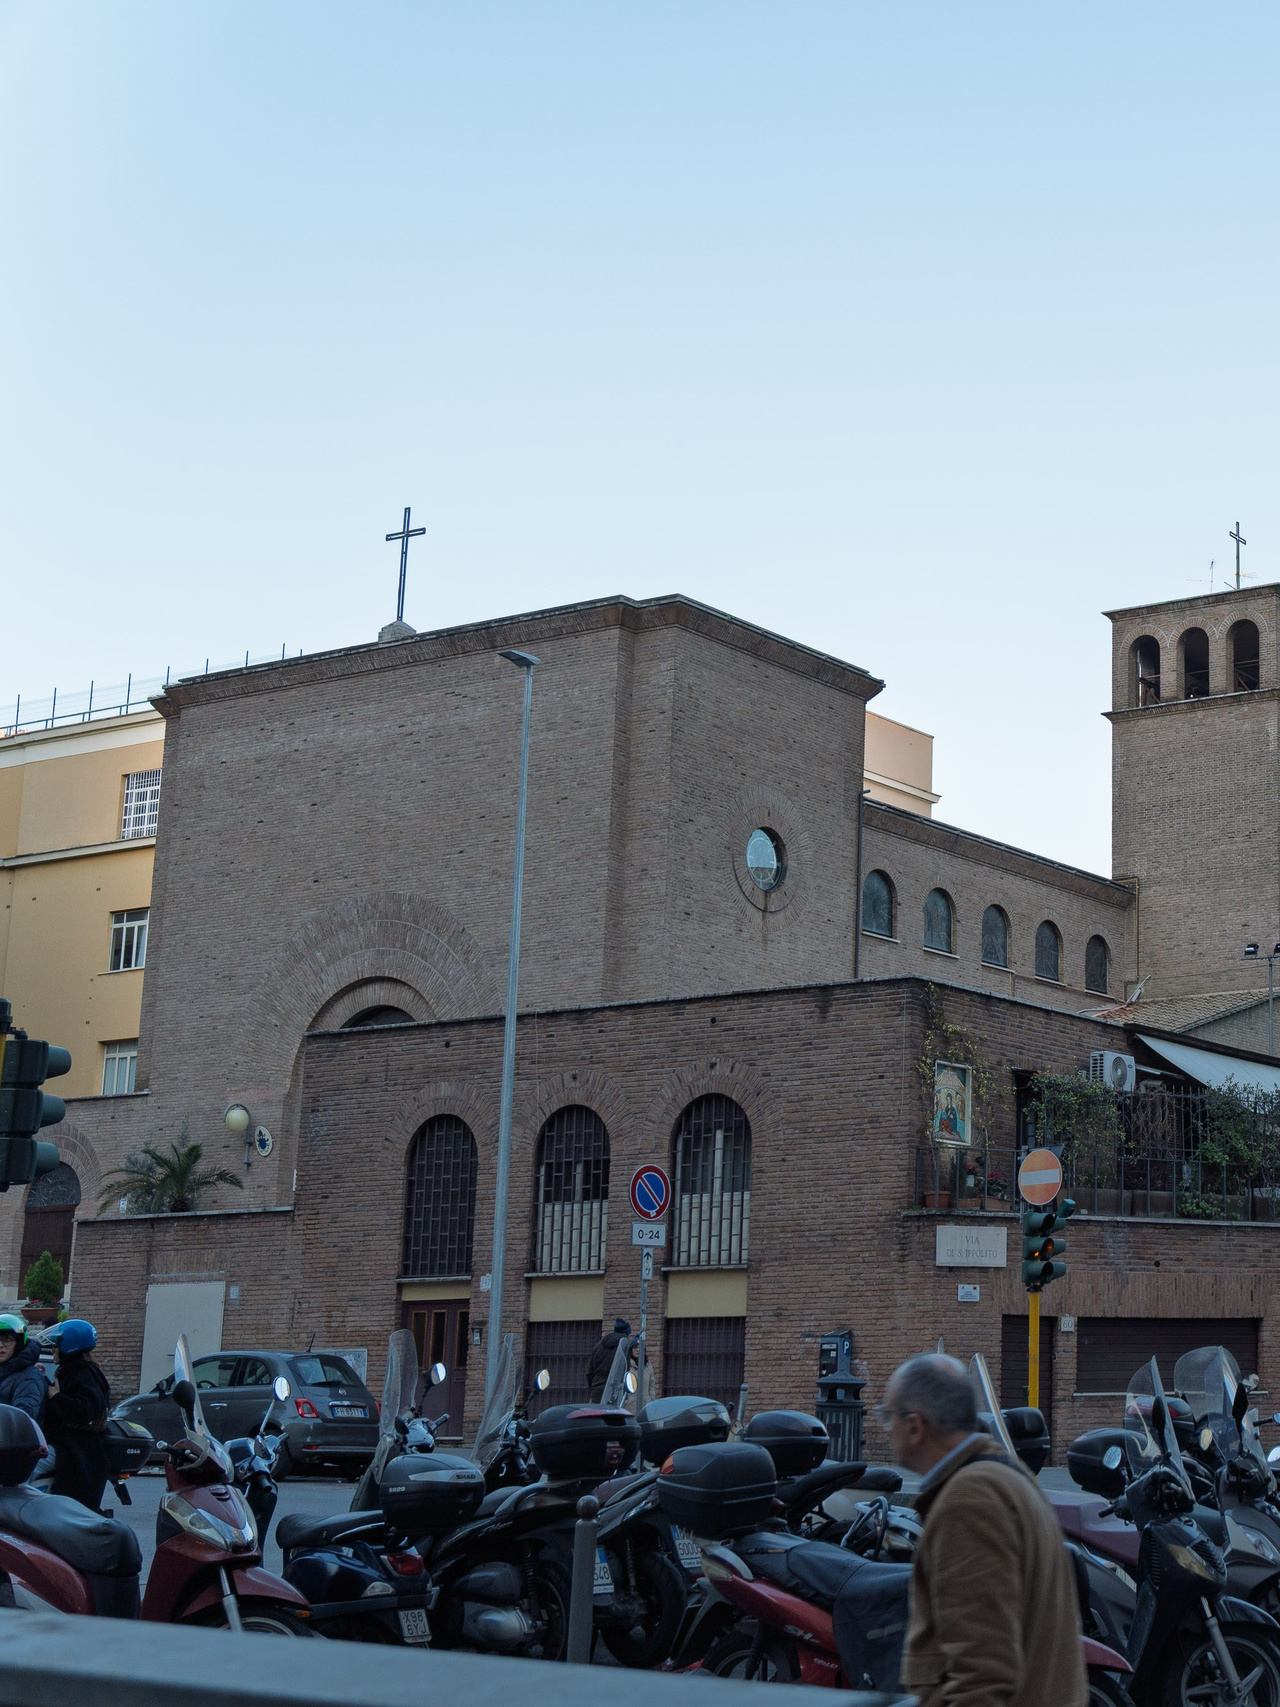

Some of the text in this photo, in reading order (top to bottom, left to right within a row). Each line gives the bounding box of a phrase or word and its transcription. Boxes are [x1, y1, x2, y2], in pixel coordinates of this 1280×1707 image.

[638, 1230, 660, 1239] 0-24
[1063, 1320, 1072, 1328] 60
[844, 1341, 849, 1353] P
[404, 1612, 424, 1623] X98
[406, 1624, 426, 1636] 6YJ
